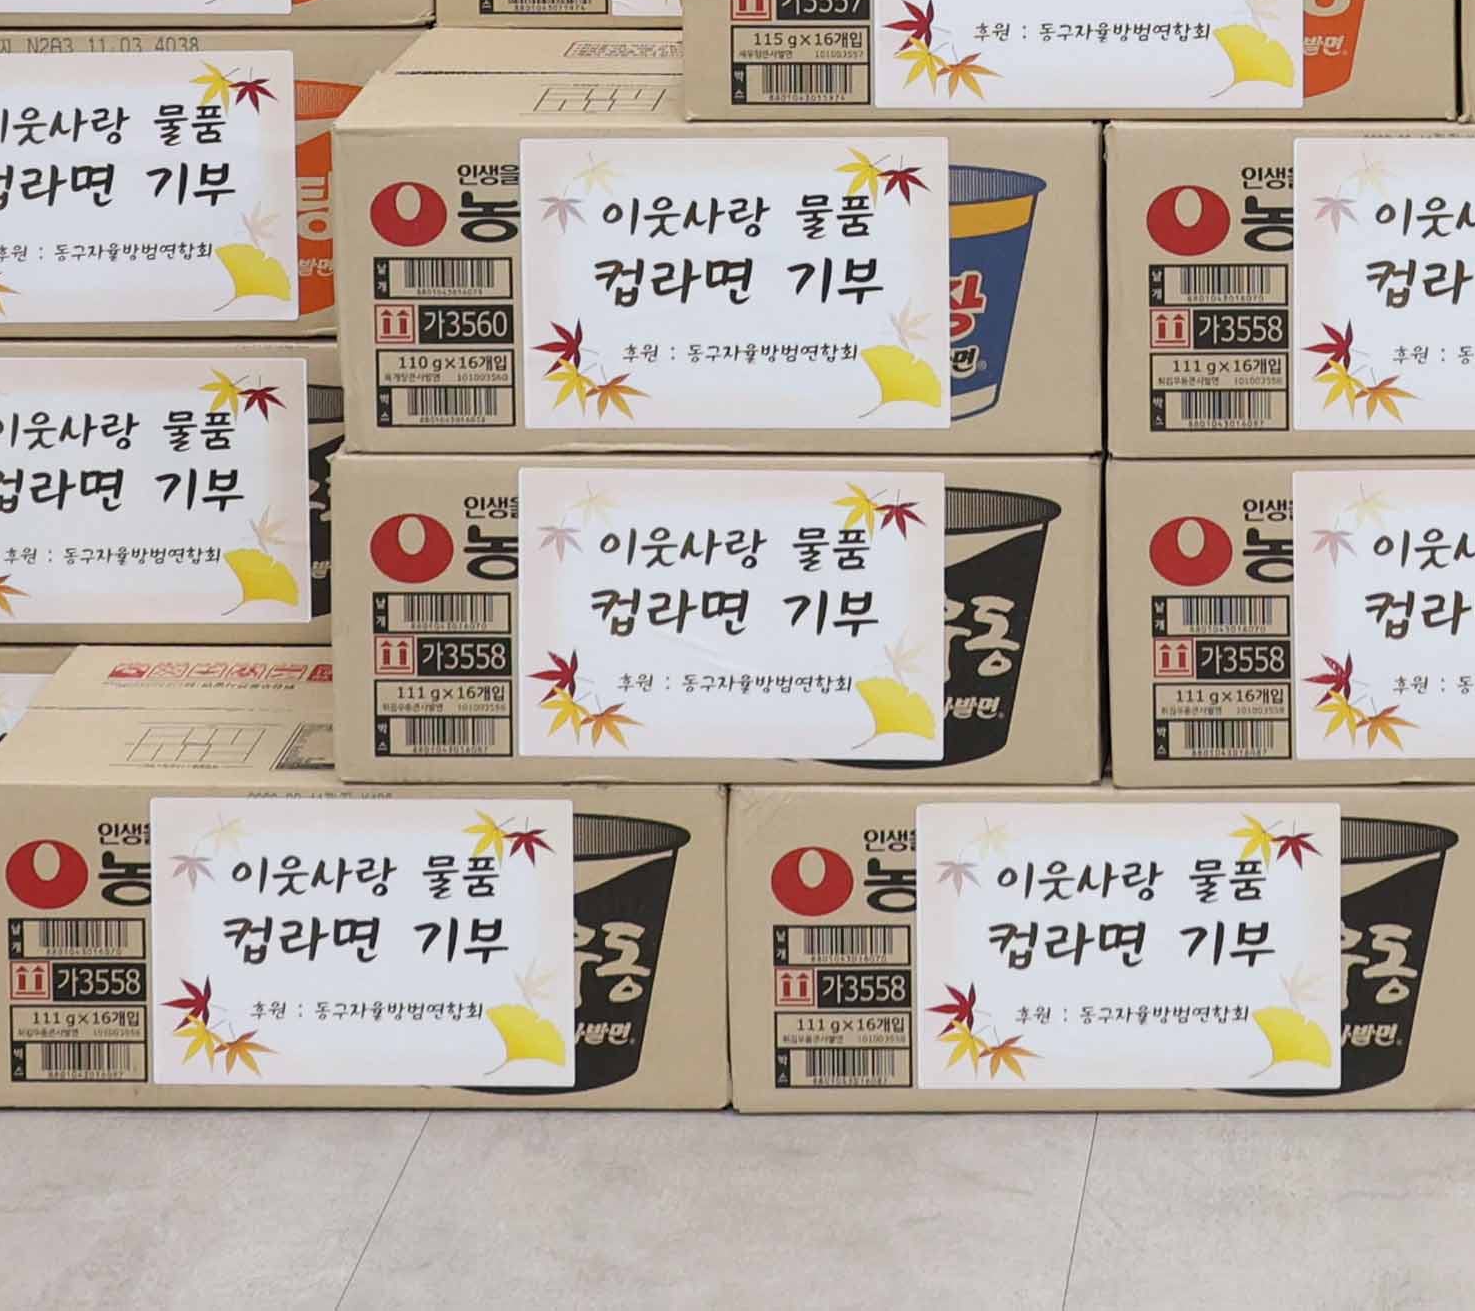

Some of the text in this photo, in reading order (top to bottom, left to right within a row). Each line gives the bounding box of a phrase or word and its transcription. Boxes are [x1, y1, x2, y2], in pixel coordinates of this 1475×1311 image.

[754, 32, 783, 46] 115
[974, 22, 1011, 42] 후원
[1039, 21, 1211, 43] 동구자율방범연합회
[153, 104, 226, 147] 물품
[146, 162, 236, 207] 기부
[602, 194, 874, 240] 이웃사랑 물품
[594, 257, 884, 308] 컵라면 기부
[424, 309, 508, 340] 가3560
[1199, 314, 1284, 345] 가3558
[399, 355, 428, 369] 110
[622, 343, 659, 363] 후원
[687, 342, 858, 364] 동구자율방범연합회
[1173, 359, 1201, 373] 111
[162, 410, 235, 453] 물품
[154, 468, 245, 512] 기부
[600, 527, 870, 572] 이웃사랑 물품
[591, 588, 879, 638] 컵라면 기부
[232, 855, 499, 900] 이웃사랑 물품
[997, 859, 1266, 904] 이웃사랑 물품
[223, 916, 509, 965] 컵라면 기부
[988, 920, 1275, 970] 컵라면 기부
[57, 967, 141, 998] 가3558
